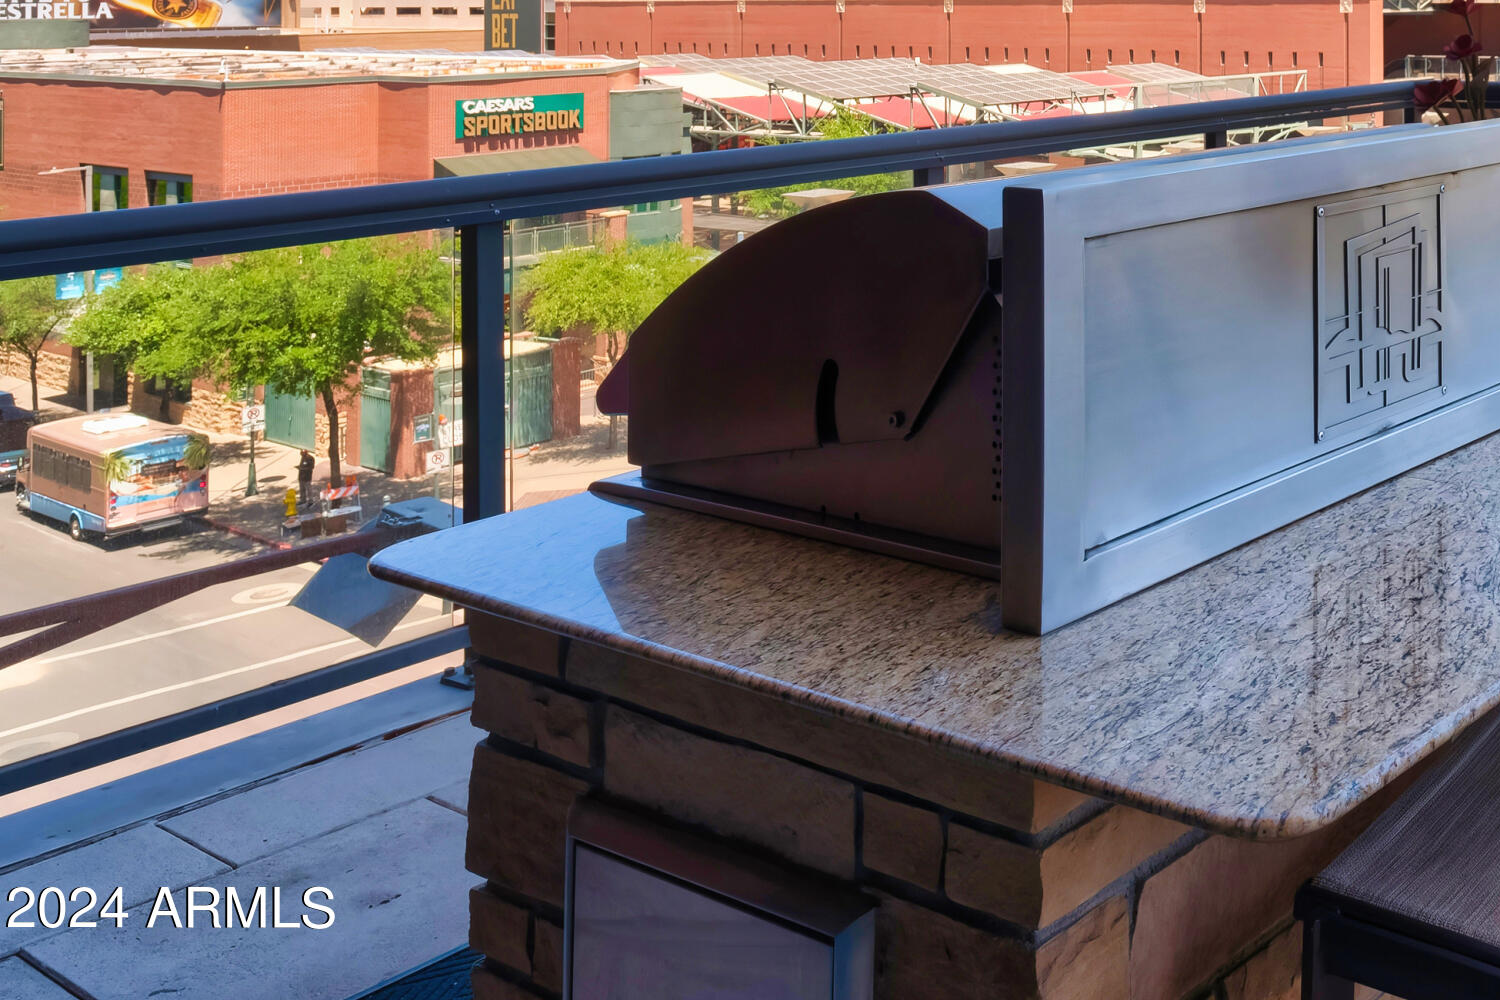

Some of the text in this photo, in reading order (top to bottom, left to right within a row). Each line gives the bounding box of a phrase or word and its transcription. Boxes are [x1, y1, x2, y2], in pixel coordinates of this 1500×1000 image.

[491, 13, 518, 48] BET
[462, 97, 535, 114] CAESARS
[463, 109, 581, 137] SPORTSBOOK
